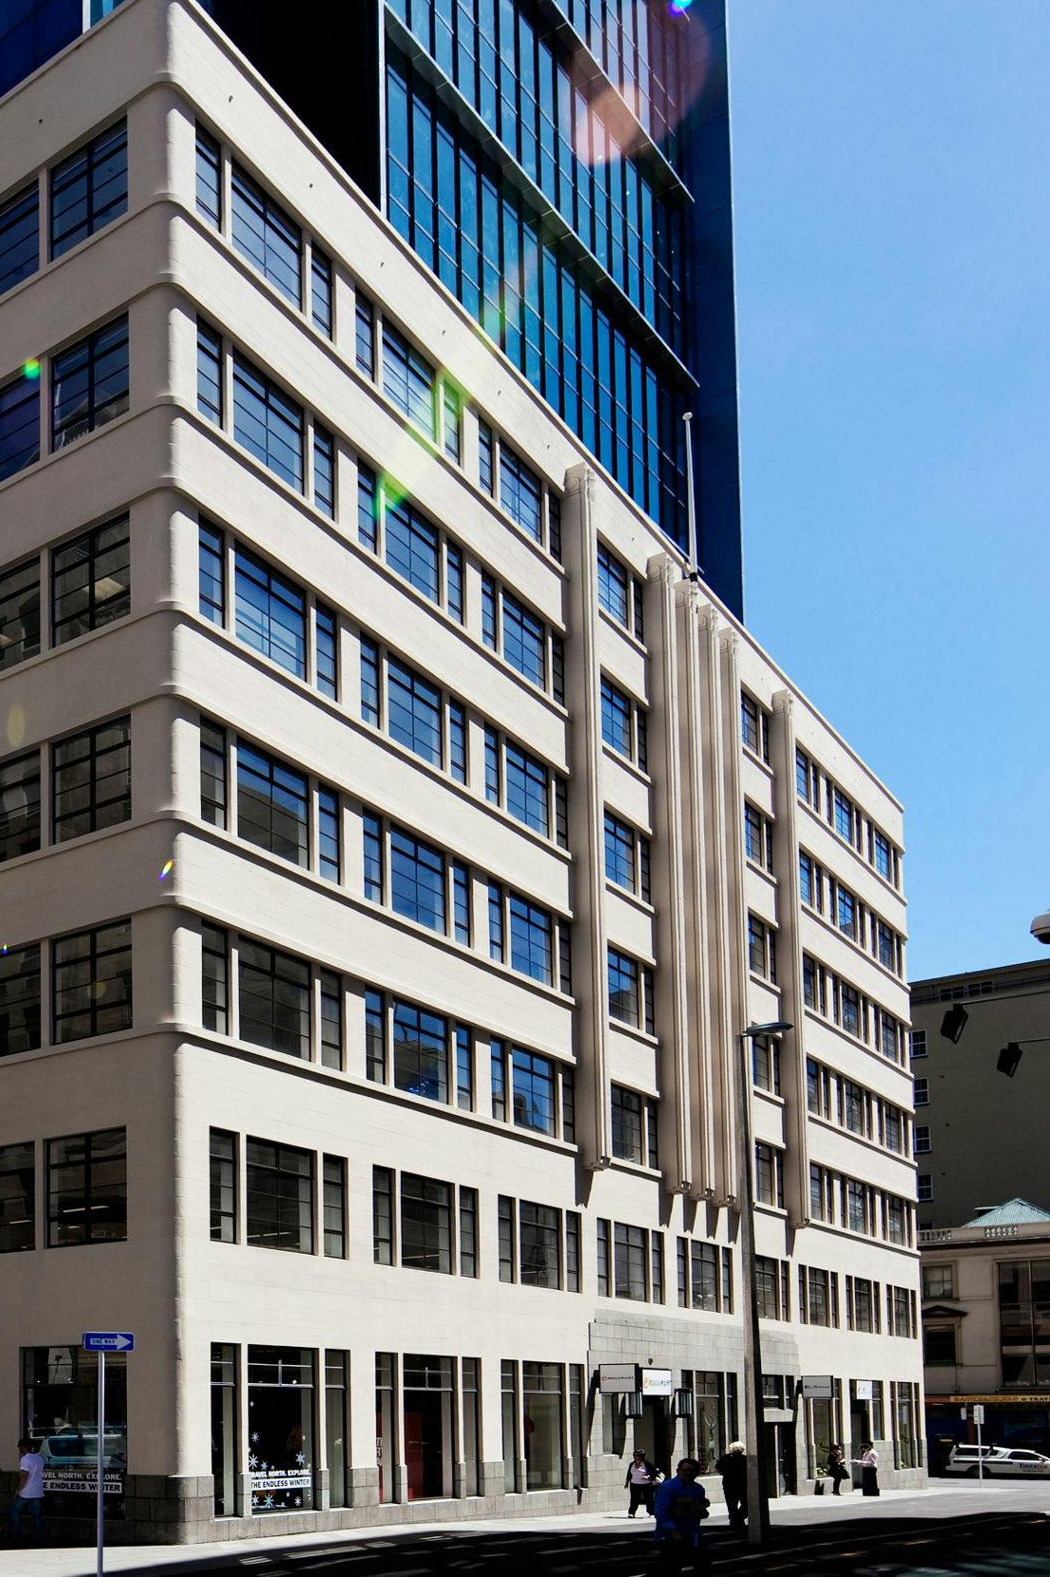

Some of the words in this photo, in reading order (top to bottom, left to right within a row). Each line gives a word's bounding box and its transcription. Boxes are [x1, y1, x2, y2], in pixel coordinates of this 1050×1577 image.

[251, 1481, 261, 1489] THE
[263, 1480, 288, 1488] ENDLESS
[289, 1478, 310, 1486] WINTER
